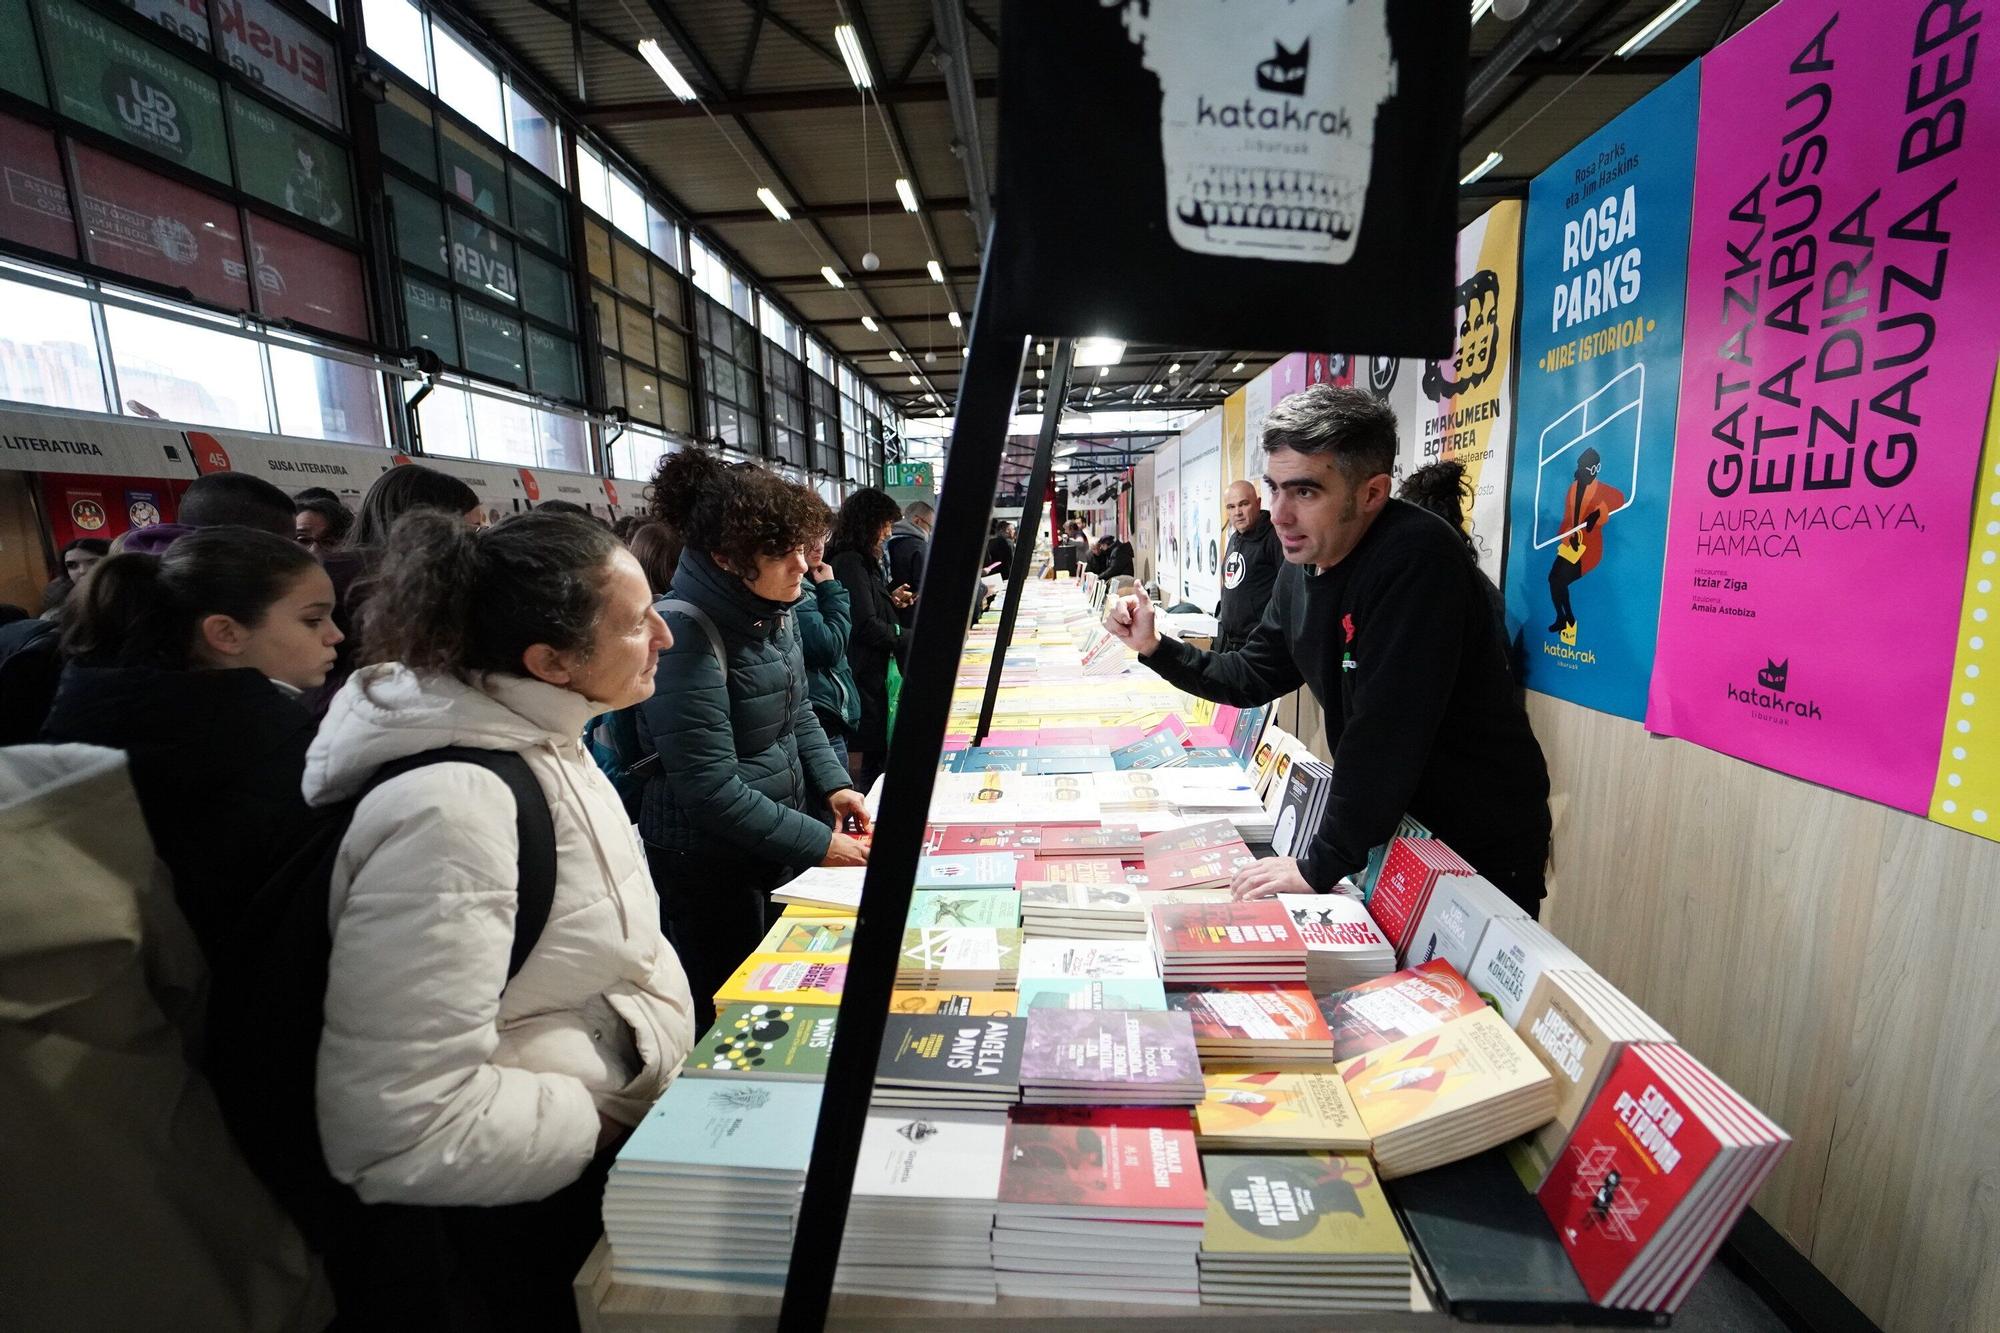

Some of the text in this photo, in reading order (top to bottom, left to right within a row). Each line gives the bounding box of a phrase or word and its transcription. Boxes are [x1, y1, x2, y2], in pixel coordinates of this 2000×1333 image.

[1197, 94, 1353, 139] katakrak
[1565, 153, 1639, 210] eta Jim Haskins
[1575, 142, 1626, 186] Rosa Parks
[1562, 184, 1636, 273] ROSA
[1748, 10, 1840, 495] ETA ABUSUA
[1552, 247, 1642, 334] PARKS
[1546, 316, 1645, 375] NIRE ISTORIOA
[1707, 171, 1771, 498] GATAZKA
[1802, 187, 1882, 492] EZ DIRA
[1863, 176, 1959, 489] GAUZA
[1424, 398, 1501, 437] EMAKUMEEN
[3, 434, 103, 457] LITERATURA
[208, 452, 226, 468] 45
[1423, 428, 1476, 457] BOTEREA
[268, 459, 349, 476] SUSA LITERATURA
[887, 464, 899, 485] 01
[1699, 503, 1926, 533] LAURA MACAYA,
[1696, 534, 1802, 558] HAMACA
[1693, 576, 1749, 592] Itziar Ziga
[1691, 602, 1757, 618] Amaia Astobiza
[1544, 640, 1596, 665] katakrak
[1727, 683, 1823, 721] katakrak
[1300, 931, 1382, 945] HANNAH
[796, 962, 825, 992] FEDERICI
[814, 966, 836, 988] SILVIA
[1487, 960, 1524, 1002] KOHLHAAS
[1496, 948, 1526, 986] MICHAEL
[809, 1017, 835, 1050] DAVIS
[946, 1027, 981, 1069] DAVIS
[973, 1020, 1009, 1077] ANGELA
[1543, 1007, 1588, 1061] URPEAN
[1145, 1046, 1161, 1077] hooks
[1160, 1046, 1177, 1066] bell
[1150, 1127, 1170, 1188] KOBAYASHI
[1164, 1139, 1183, 1174] TAKIJI
[1230, 1188, 1255, 1213] BAT
[1246, 1176, 1280, 1226] PRIBATU
[1268, 1180, 1300, 1222] KONTU
